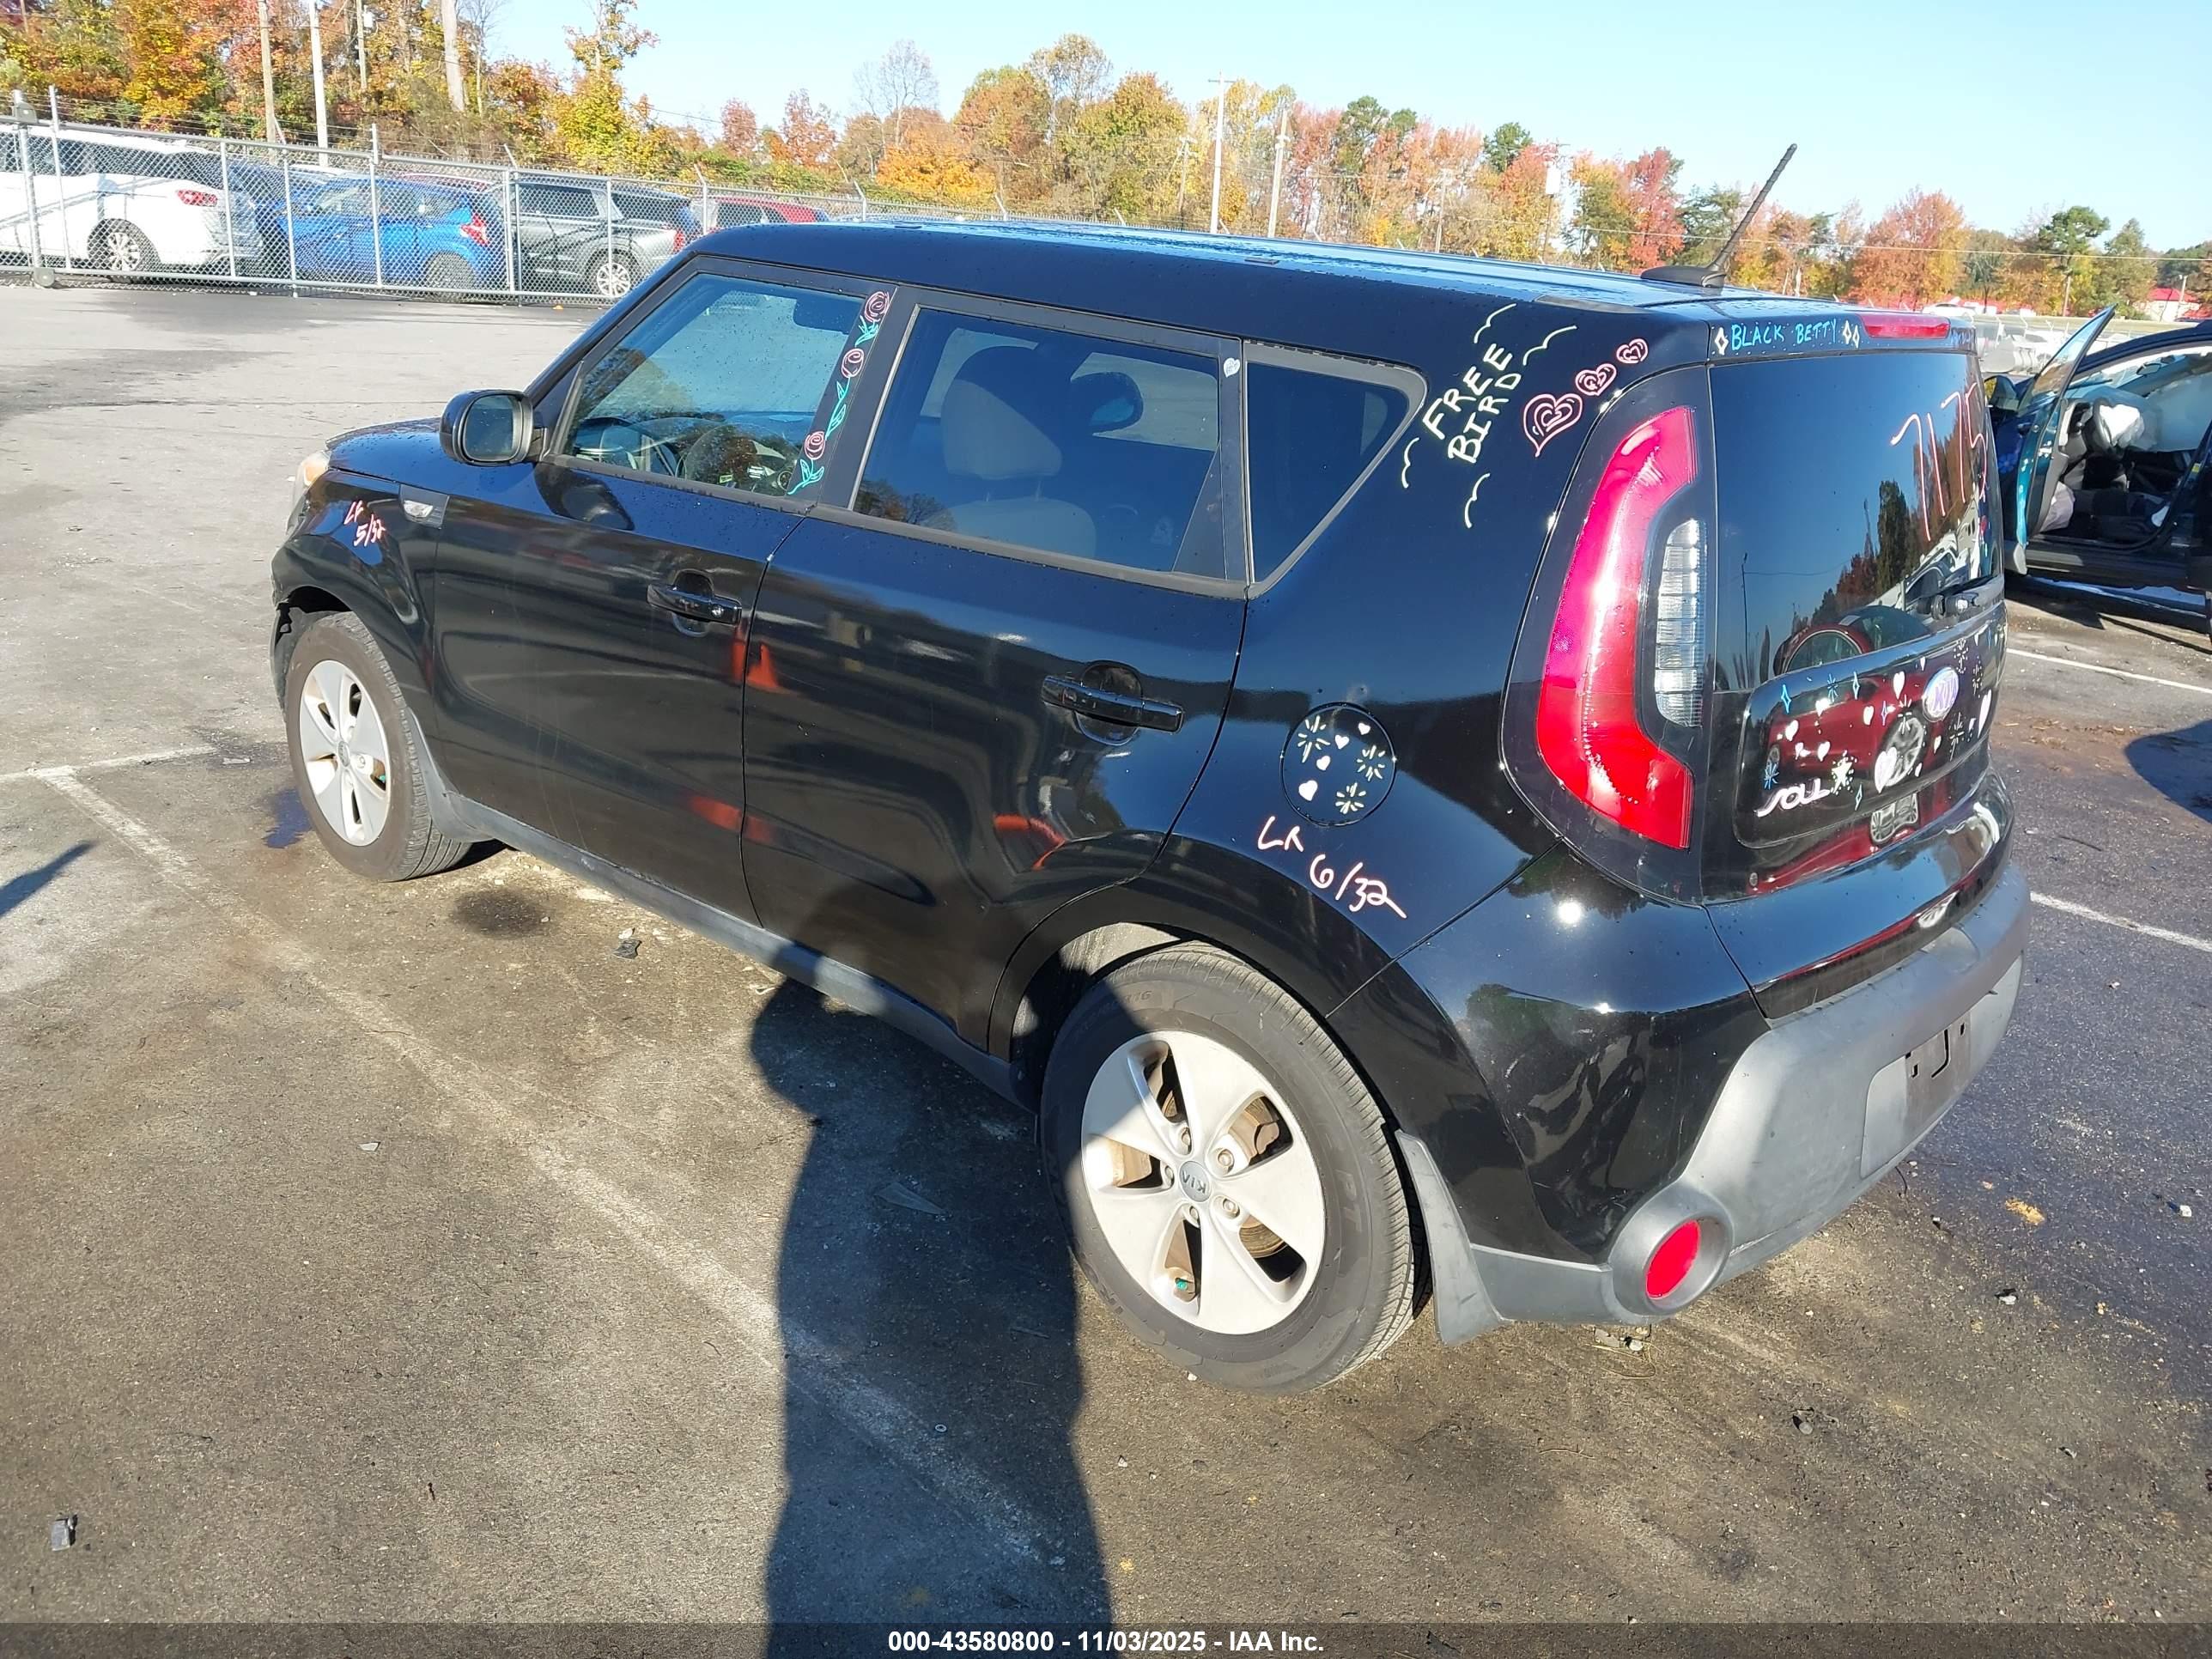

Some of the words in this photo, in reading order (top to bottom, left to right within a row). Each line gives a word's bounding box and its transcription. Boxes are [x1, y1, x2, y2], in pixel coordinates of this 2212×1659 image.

[1730, 323, 1784, 350] BLACK
[1795, 319, 1837, 344] BETTY
[1422, 343, 1512, 440] FREE
[1447, 371, 1521, 464] BIRD
[1256, 816, 1304, 852] LR
[1309, 854, 1407, 919] 6/32
[1182, 1170, 1206, 1194] KIA
